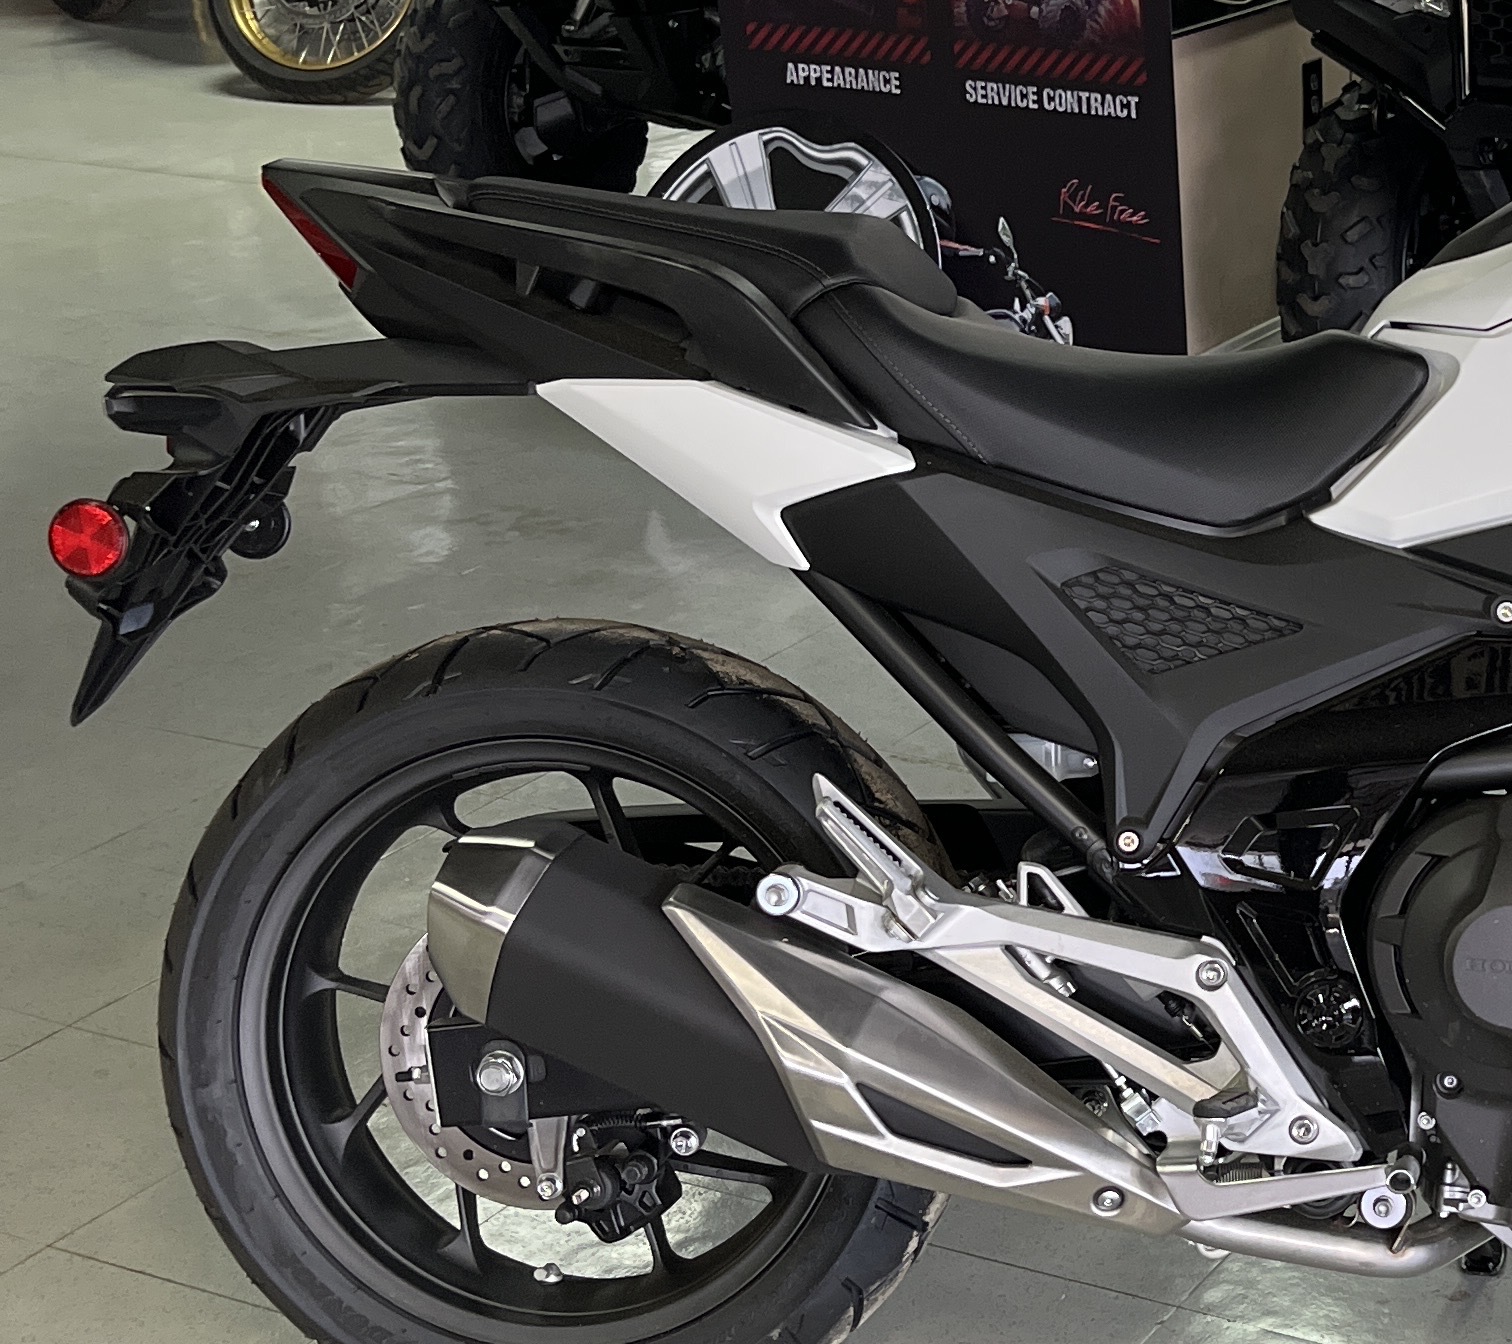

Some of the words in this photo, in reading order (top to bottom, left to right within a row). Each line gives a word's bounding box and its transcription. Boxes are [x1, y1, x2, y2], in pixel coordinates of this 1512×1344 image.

[786, 62, 901, 95] APPEARANCE
[965, 79, 1039, 111] SERVICE
[1042, 88, 1140, 120] CONTRACT
[1105, 191, 1152, 226] Free
